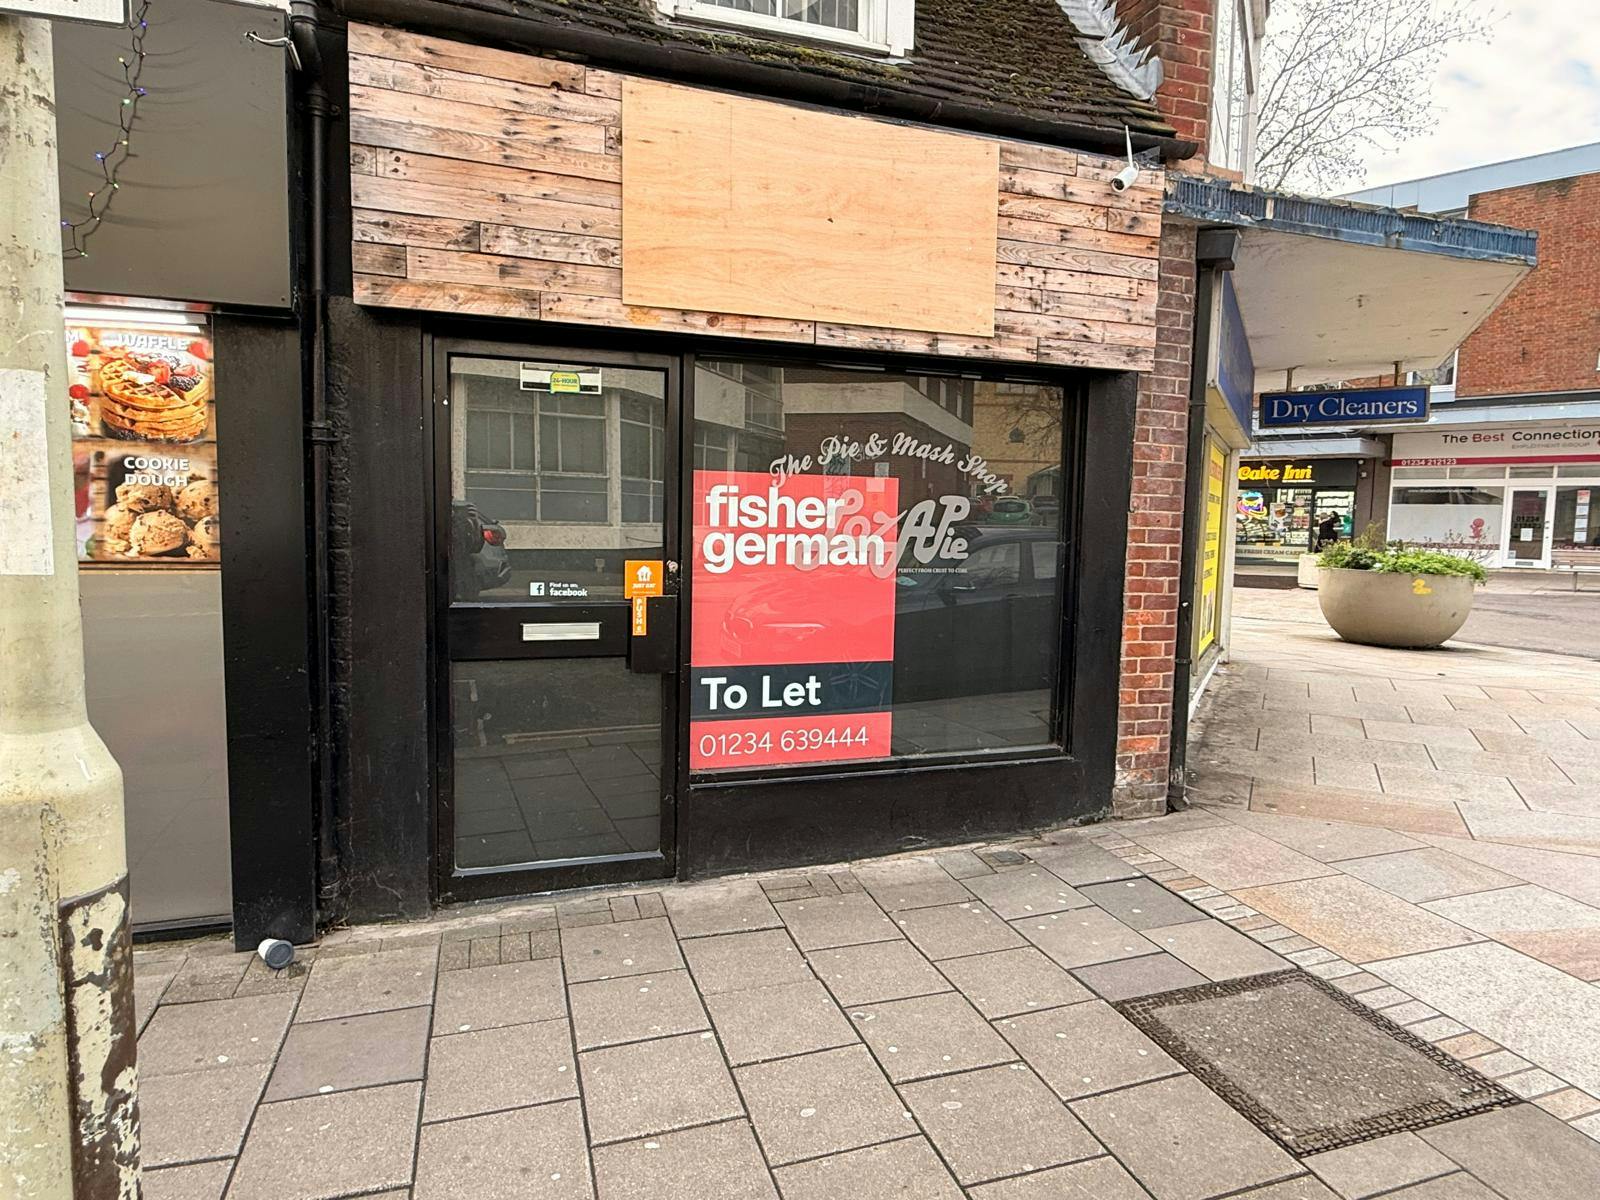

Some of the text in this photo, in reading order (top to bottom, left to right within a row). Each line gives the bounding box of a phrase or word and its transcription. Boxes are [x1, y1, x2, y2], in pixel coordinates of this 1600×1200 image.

[119, 334, 188, 350] WAFFLE
[1271, 397, 1418, 422] Dry Cleaners
[1442, 429, 1600, 444] The Best Connection
[123, 456, 190, 471] COOKIE
[769, 431, 1008, 493] The Pie & Mash Shop
[1427, 458, 1457, 466] 212123
[124, 473, 188, 487] DOUGH
[1238, 466, 1280, 481] Cake
[1283, 464, 1313, 480] Inn
[706, 485, 846, 529] fisher
[702, 532, 885, 574] german
[549, 588, 588, 597] facebook
[700, 675, 822, 710] To Let
[700, 726, 869, 757] 01234 639444
